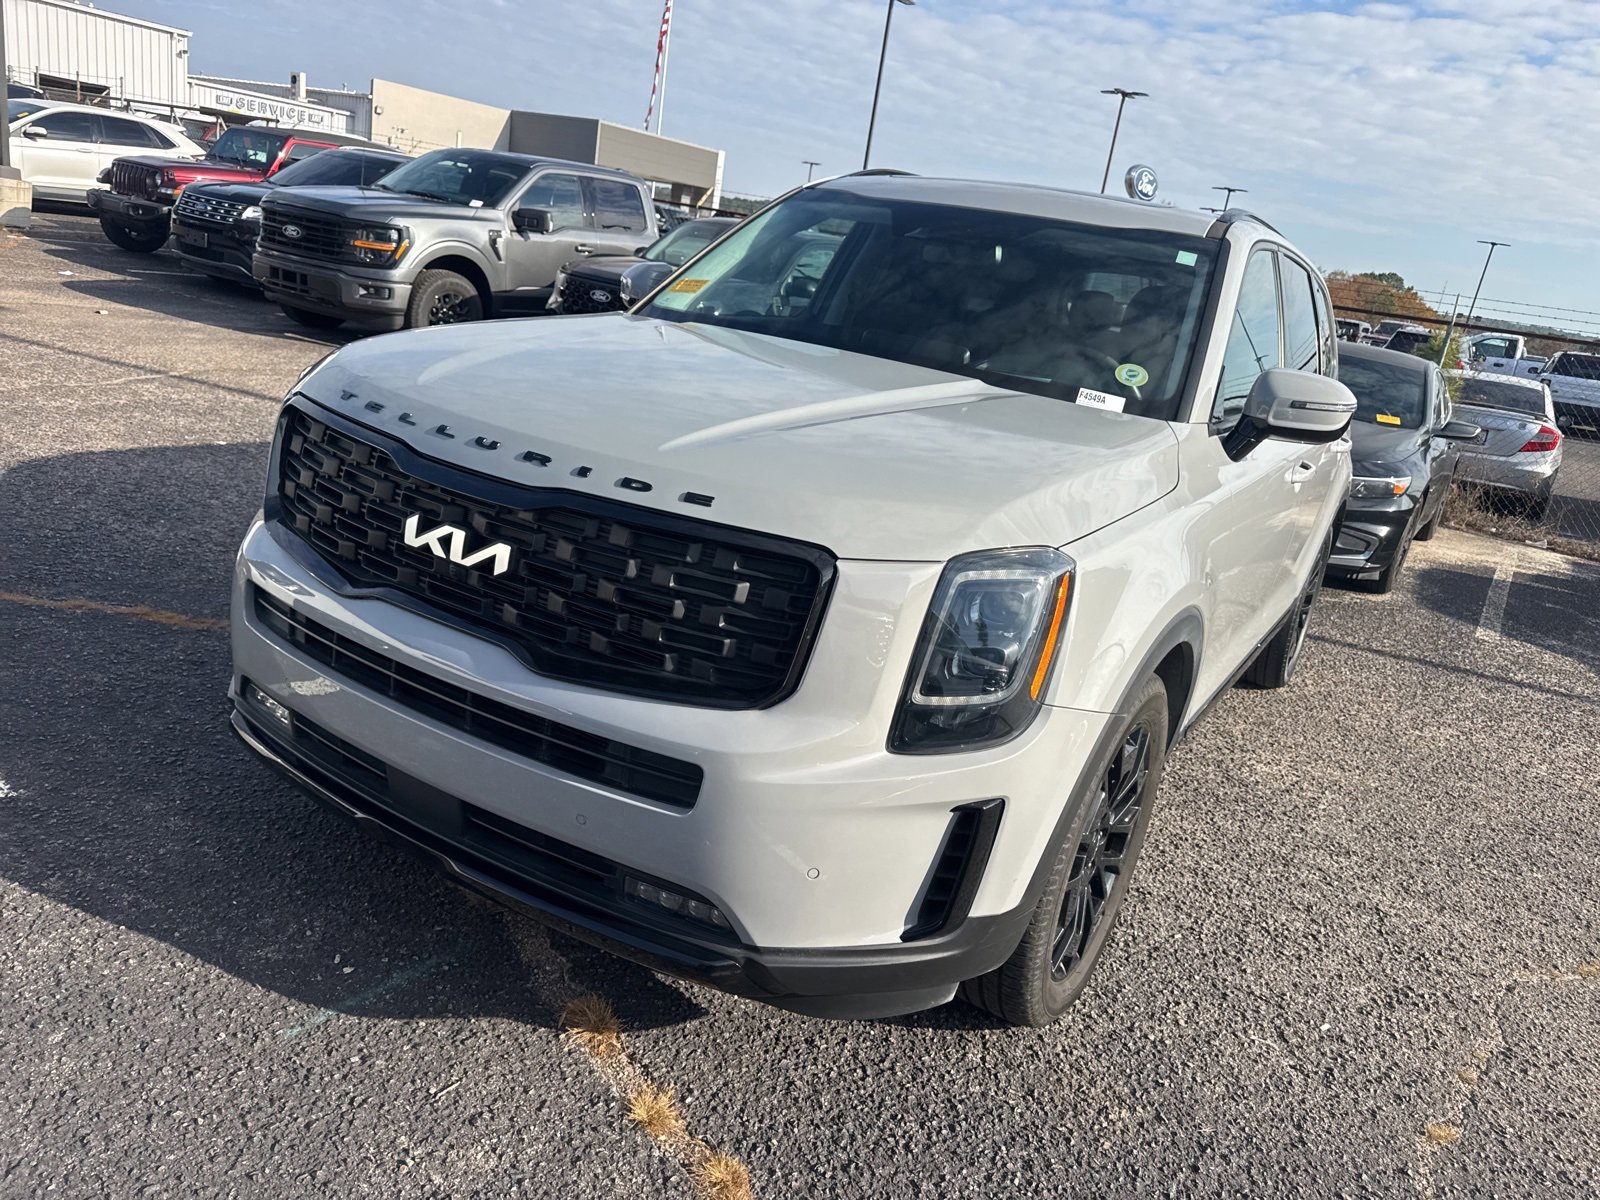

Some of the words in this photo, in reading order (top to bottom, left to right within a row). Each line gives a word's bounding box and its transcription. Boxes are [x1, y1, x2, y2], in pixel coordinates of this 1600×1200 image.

[235, 97, 306, 122] SERVICE
[1079, 390, 1106, 404] F4549A
[340, 389, 716, 508] TELLURIDE
